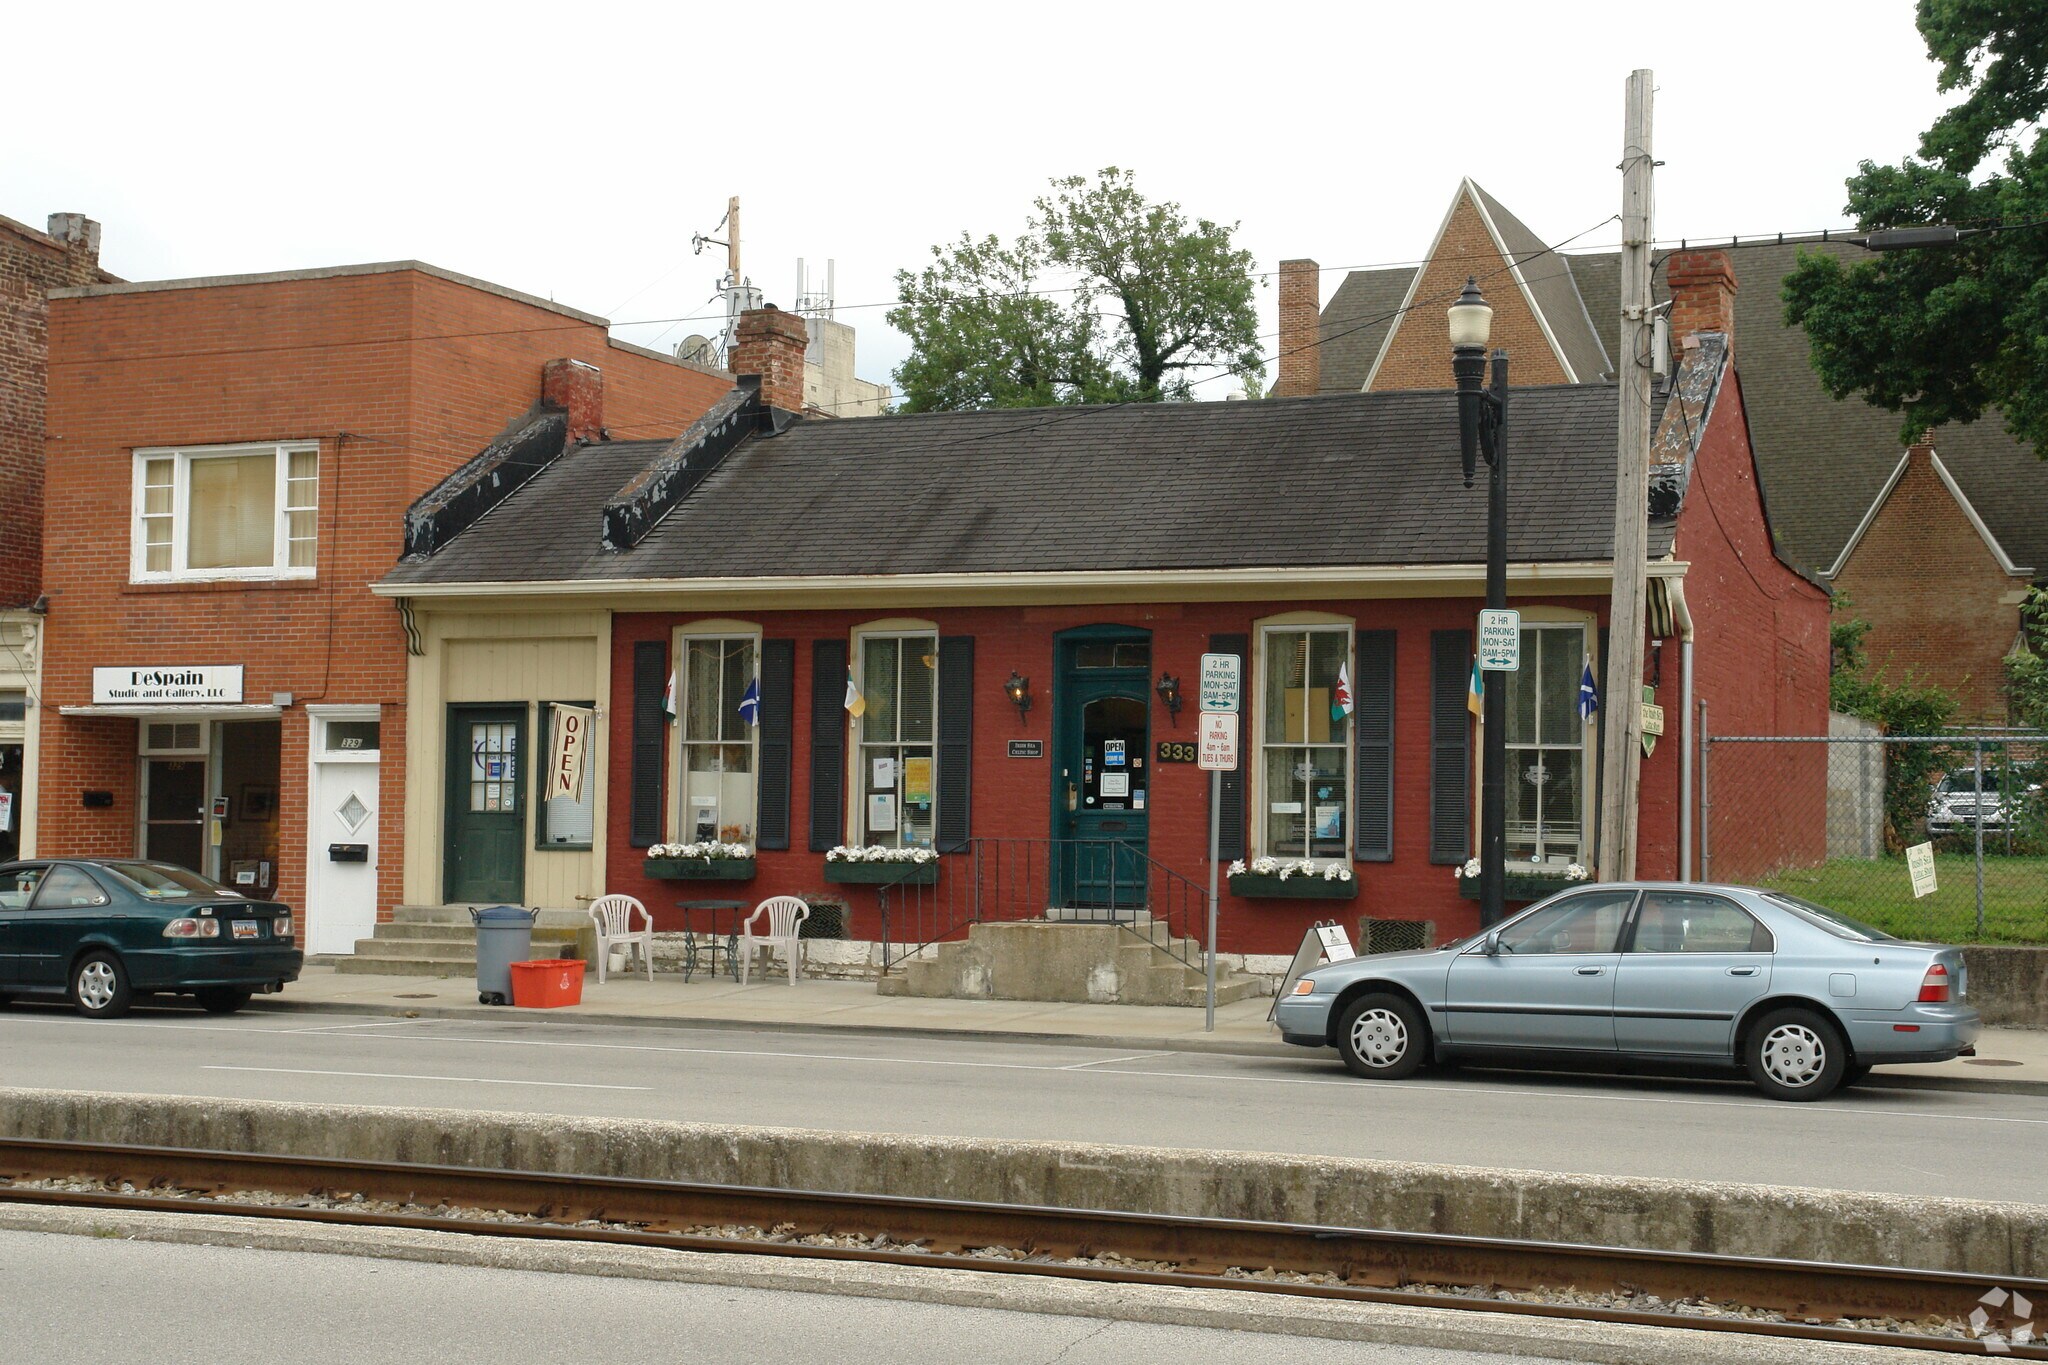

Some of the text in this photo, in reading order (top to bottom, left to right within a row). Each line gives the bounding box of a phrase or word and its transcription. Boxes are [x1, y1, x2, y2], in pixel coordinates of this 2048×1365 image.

[1491, 616, 1508, 625] 2 HR
[1484, 627, 1515, 636] PARKING
[1482, 638, 1516, 647] MON-SAT
[1482, 649, 1516, 657] 8AM-5PM
[1212, 660, 1230, 669] 2 HR
[131, 670, 204, 686] DeSpain
[1205, 670, 1236, 679] PARKING
[1203, 681, 1237, 690] MON-SAT
[108, 688, 226, 698] Studio and Gallery, LLC
[1203, 691, 1237, 700] 8AM-5PM
[1215, 720, 1223, 729] NO
[1209, 731, 1228, 740] PARKING
[342, 738, 359, 747] 329
[1105, 742, 1124, 752] OPEN
[1206, 742, 1216, 751] 4am
[559, 715, 579, 791] OPEN
[1160, 742, 1195, 761] 333
[1202, 753, 1214, 763] TUES
[1219, 754, 1234, 763] THURS
